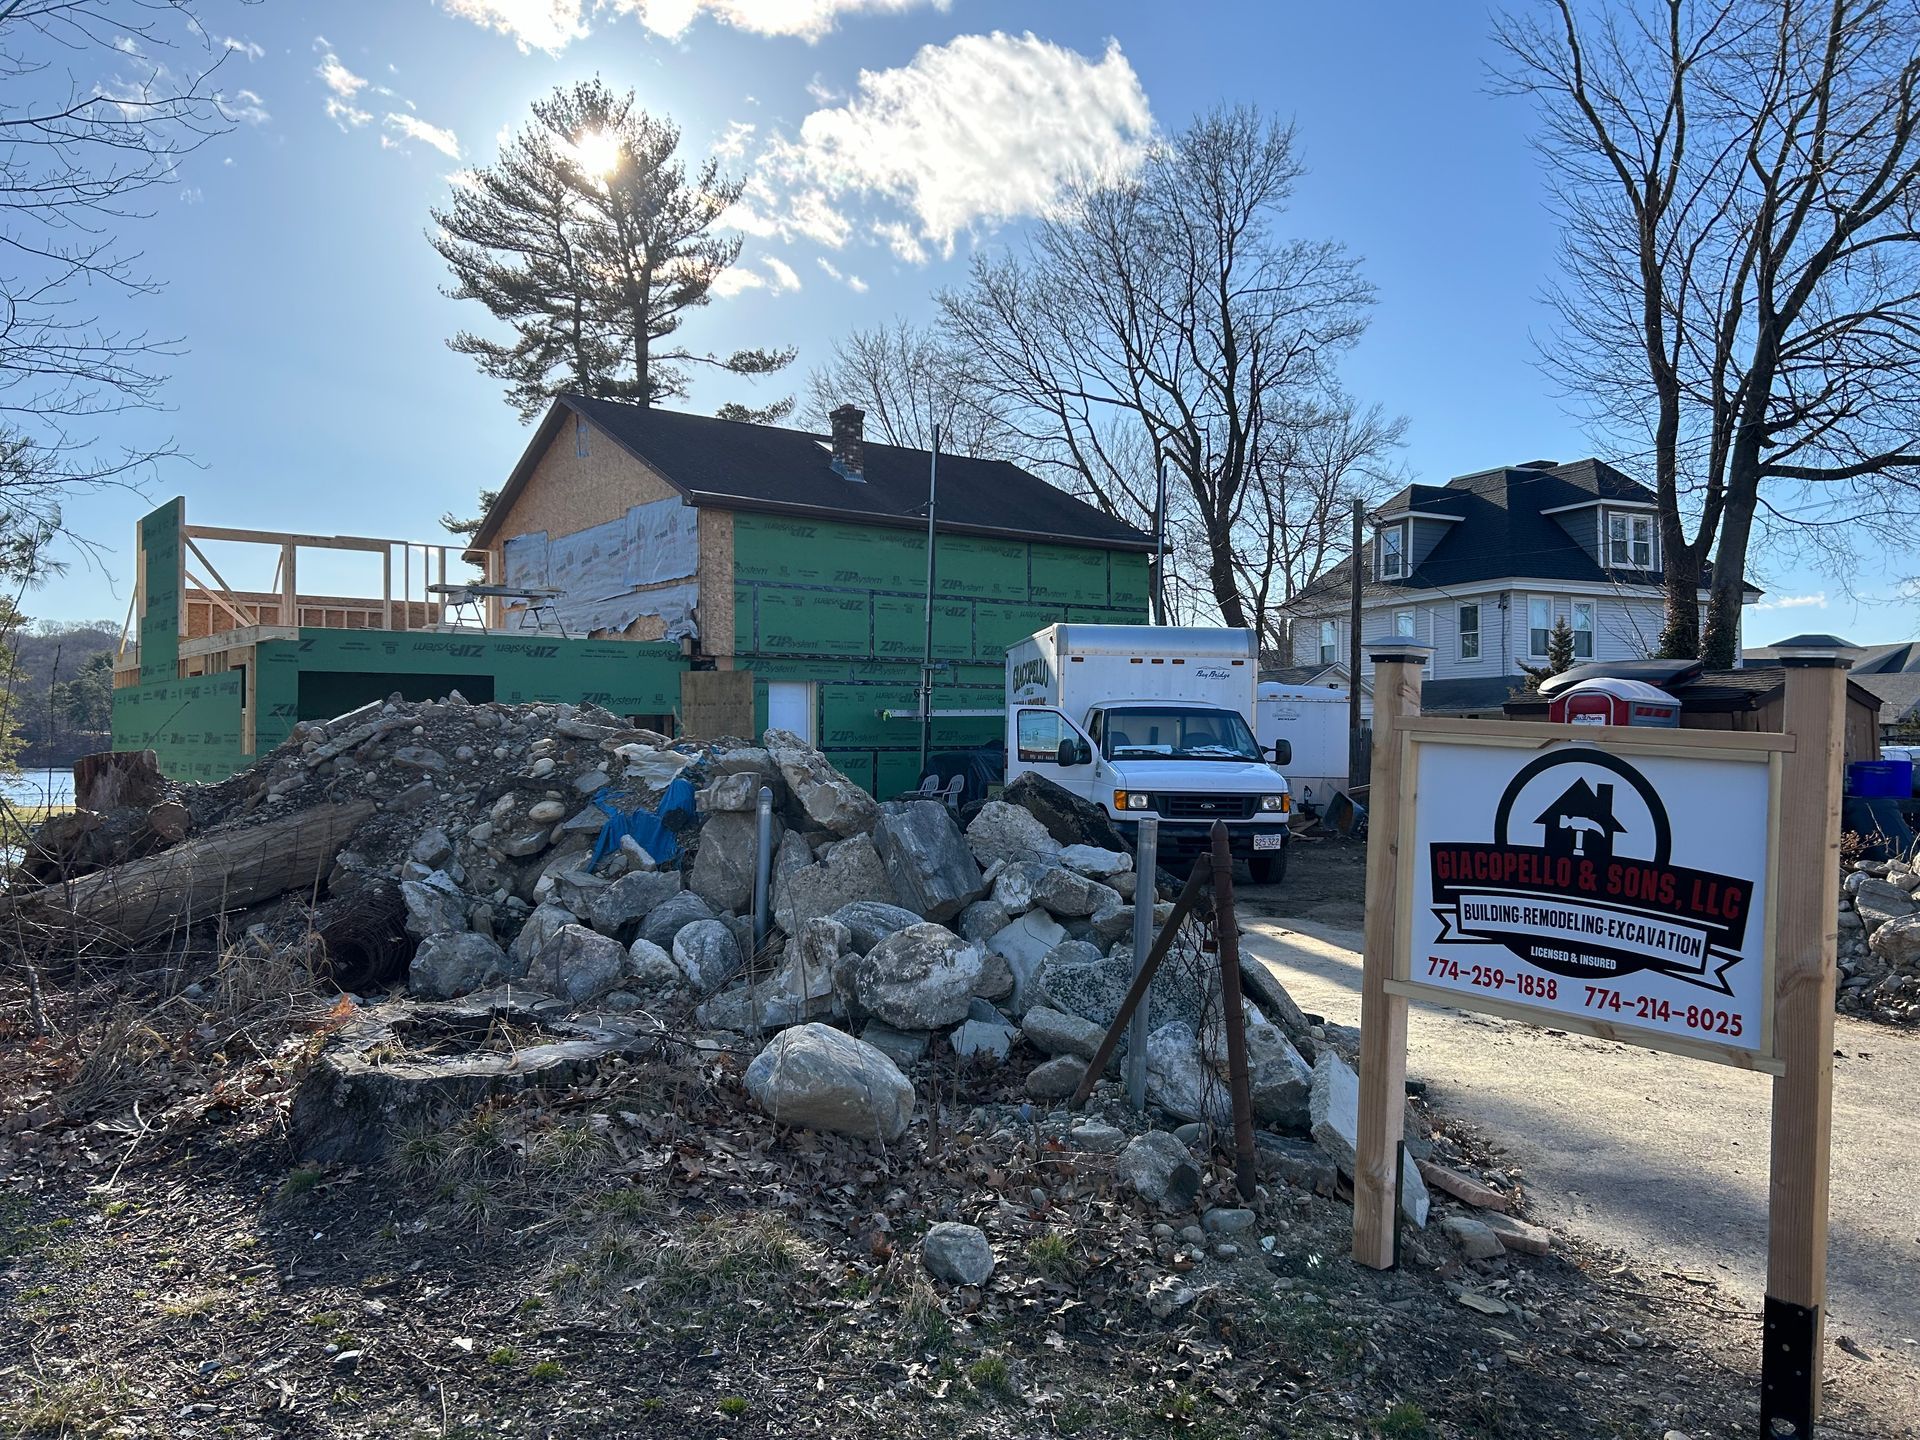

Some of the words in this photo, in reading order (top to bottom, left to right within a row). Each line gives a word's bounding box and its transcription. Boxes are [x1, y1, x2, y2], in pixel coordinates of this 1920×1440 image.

[1436, 850, 1572, 888] GIACOPELLO
[1578, 859, 1597, 891] &
[1606, 863, 1682, 910] SONS,
[1691, 879, 1742, 920] LLC
[1427, 956, 1558, 1000] 774-259-1858
[1530, 945, 1569, 962] LICENSED
[1570, 952, 1578, 964] &
[1579, 953, 1617, 970] INSURED
[1584, 985, 1743, 1037] 774-214-8025
